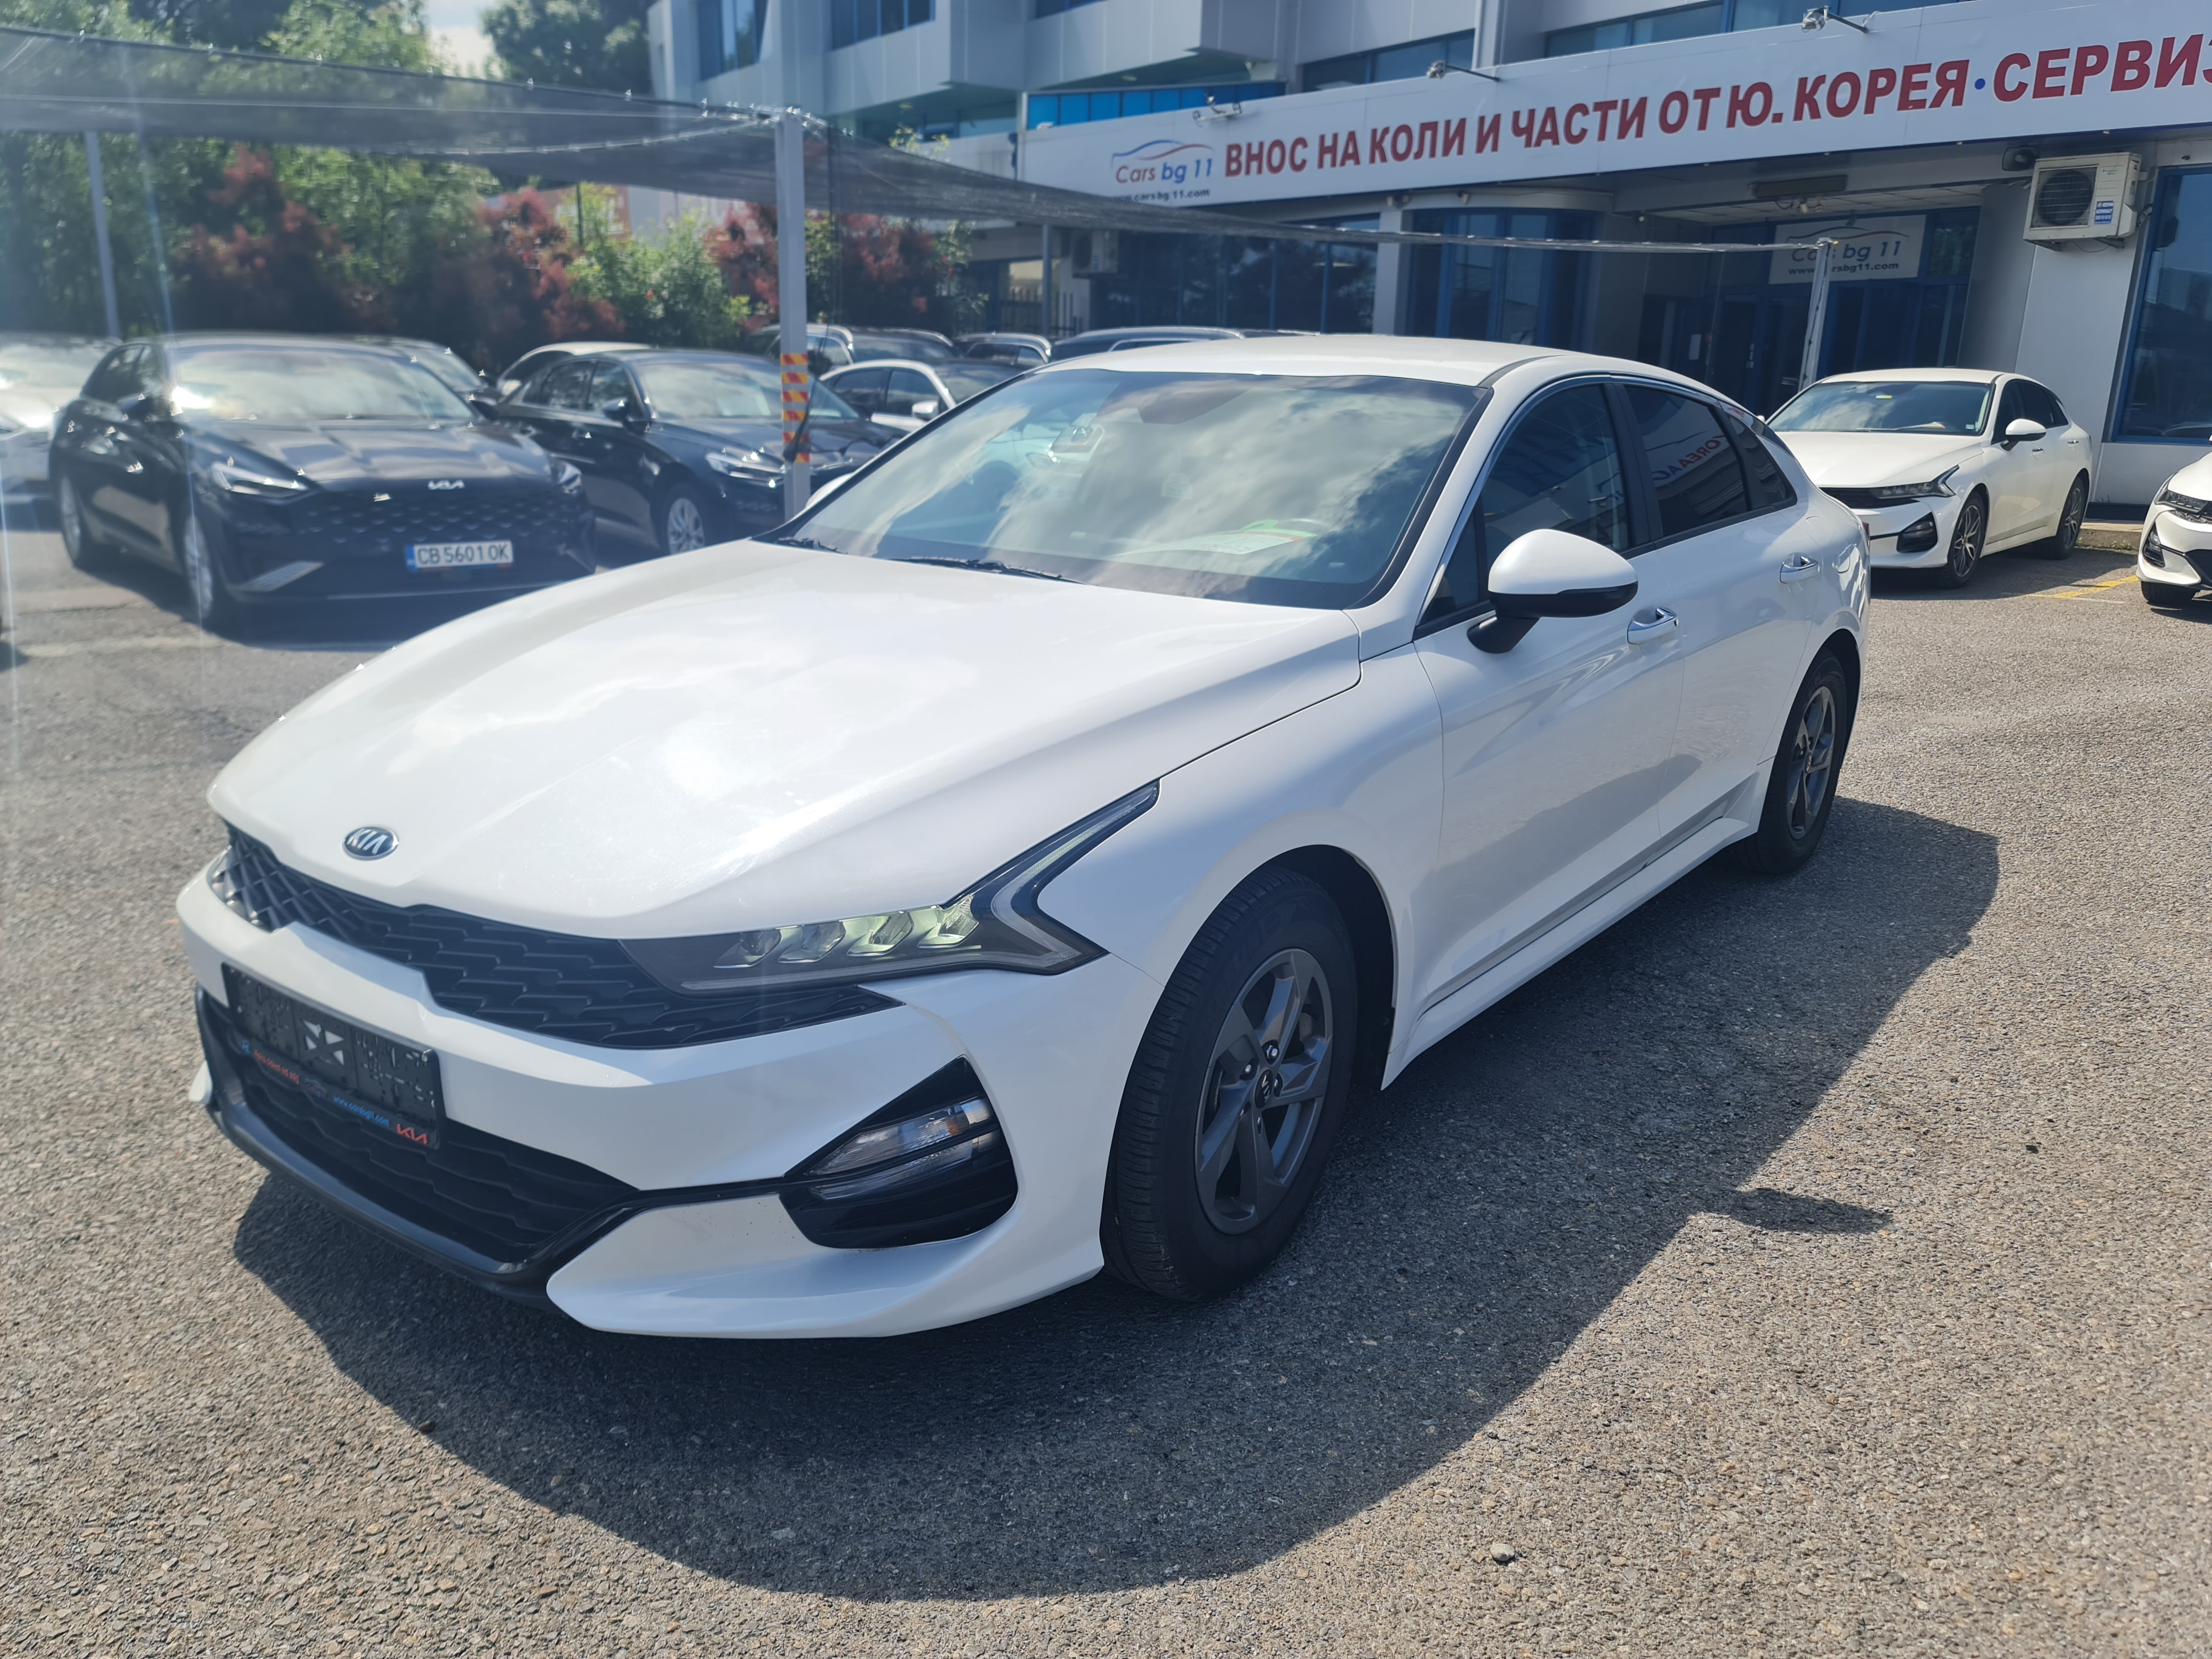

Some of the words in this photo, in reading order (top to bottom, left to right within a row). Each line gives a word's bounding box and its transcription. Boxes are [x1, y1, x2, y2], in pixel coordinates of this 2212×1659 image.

[1225, 137, 1308, 178] ВНОС
[1317, 131, 1361, 169] НА
[1369, 118, 1467, 164] КОЛИ
[1475, 114, 1501, 154] И
[1511, 97, 1647, 148] ЧАСТИ
[1658, 87, 1721, 134] ОТ
[1792, 59, 1970, 122] КОРЕЯ
[1115, 165, 1156, 184] Cars
[1161, 162, 1187, 184] bg
[1194, 158, 1213, 178] 11
[1843, 243, 1871, 262] bg
[1880, 241, 1901, 257] 11
[1788, 262, 1898, 274] wwwrsbg11.com
[418, 546, 440, 565] CB
[444, 544, 483, 563] 5601
